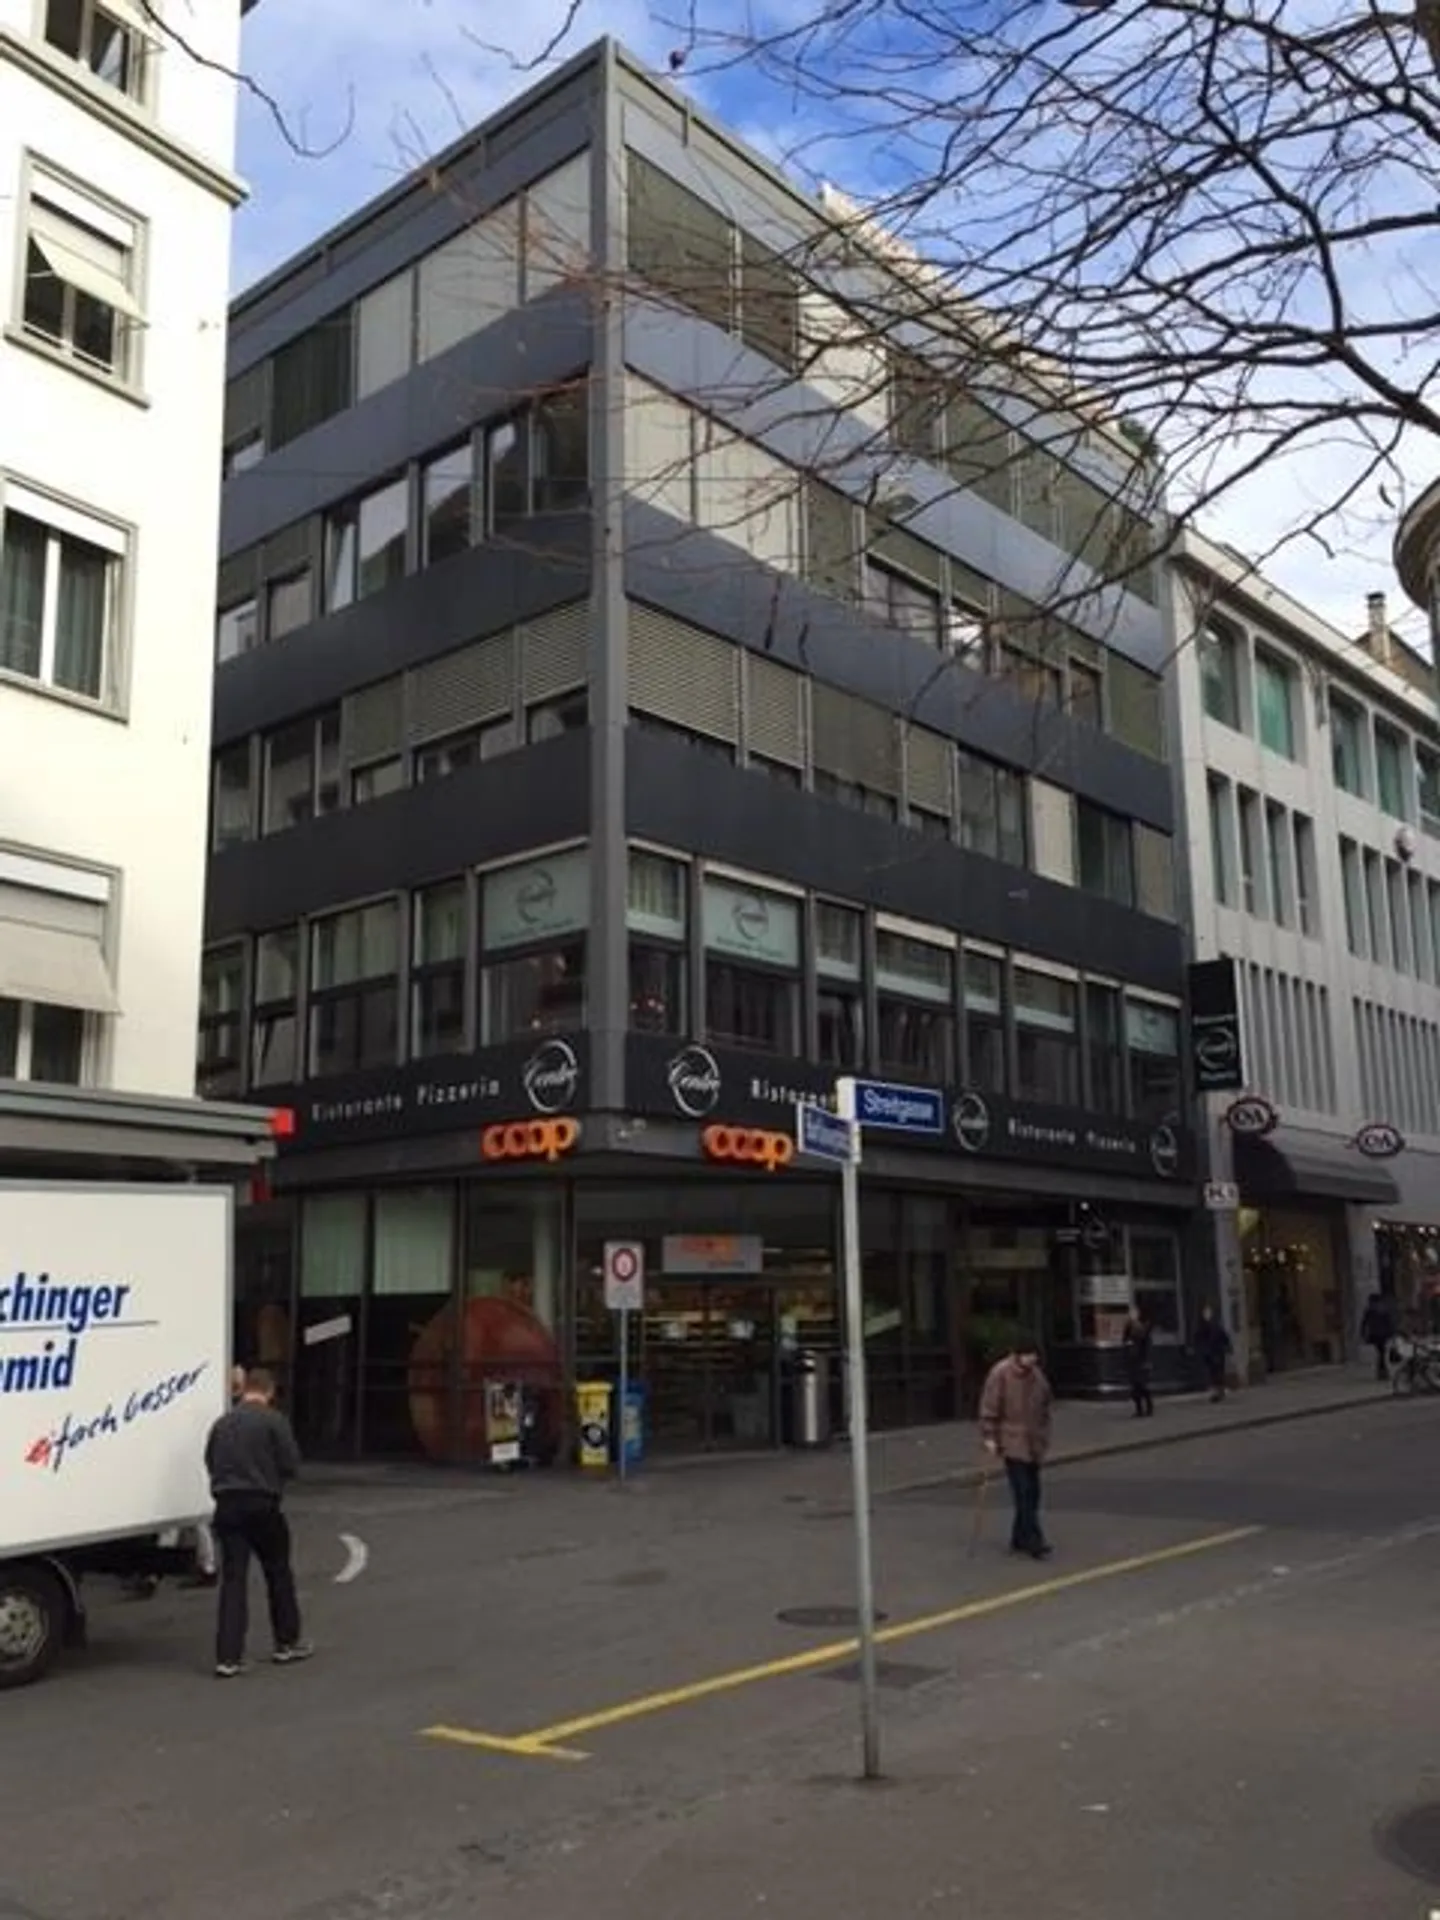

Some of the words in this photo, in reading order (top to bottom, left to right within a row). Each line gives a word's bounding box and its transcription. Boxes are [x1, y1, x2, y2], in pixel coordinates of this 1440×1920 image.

[416, 1075, 500, 1107] Pizzeria
[752, 1077, 838, 1108] Ristoran
[482, 1116, 581, 1162] coop
[704, 1125, 794, 1171] coop
[0, 1339, 78, 1393] mid
[123, 1359, 209, 1423] besser
